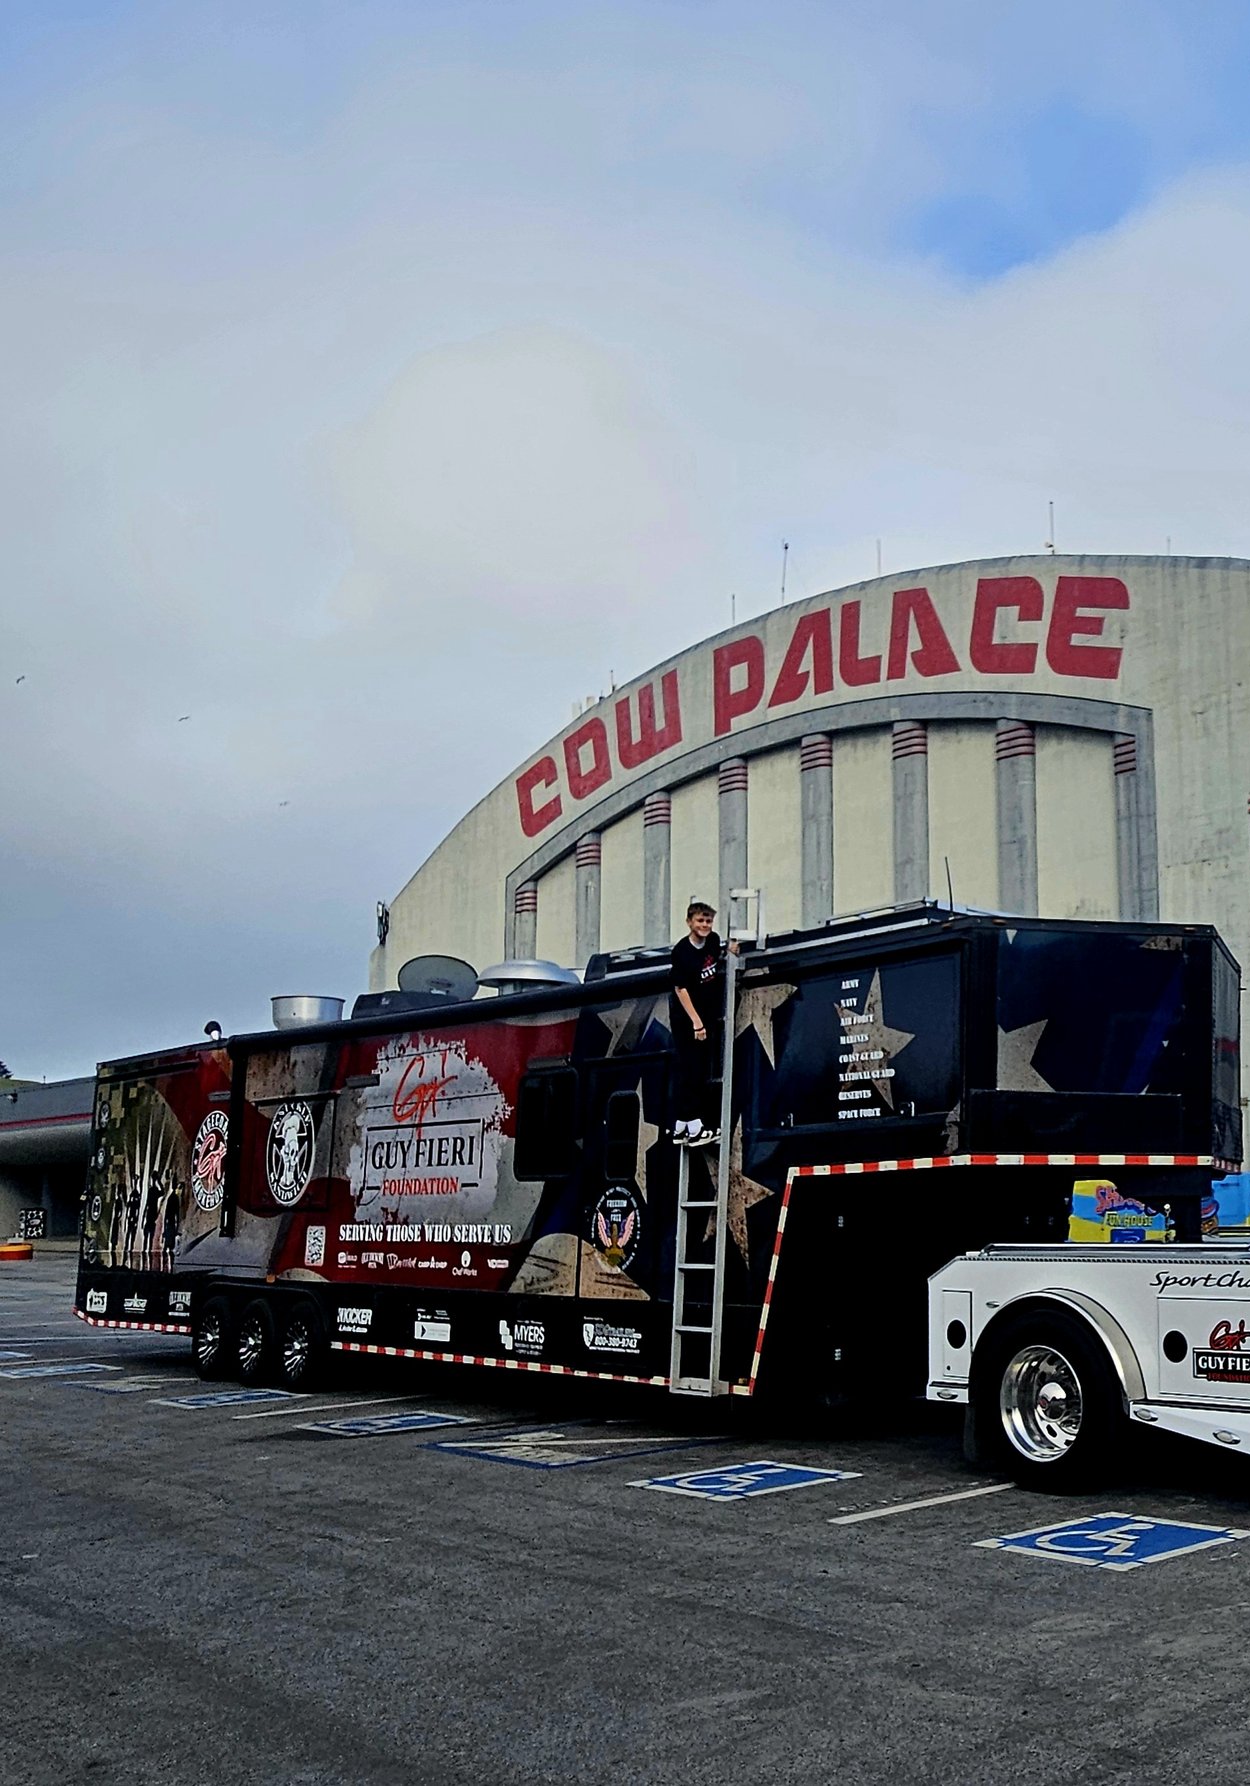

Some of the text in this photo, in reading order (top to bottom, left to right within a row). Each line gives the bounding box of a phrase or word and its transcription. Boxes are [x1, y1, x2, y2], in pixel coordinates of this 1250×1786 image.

[515, 575, 1130, 838] COW PALACE
[841, 979, 859, 990] ARMY
[840, 1014, 874, 1027] AIR FORCE
[839, 1034, 869, 1045] MARINES
[839, 1050, 884, 1064] COAST GUARD
[839, 1068, 896, 1082] NATIONAL GUARD
[838, 1090, 872, 1101] RESERVES
[838, 1107, 881, 1119] SPACE FORCE
[371, 1136, 475, 1170] GUY FIERI
[382, 1177, 459, 1196] FOUNDATION
[339, 1224, 511, 1244] SERVING THOSE WHO SERVE US
[514, 1324, 545, 1344] MYERS
[1198, 1356, 1226, 1371] GUY
